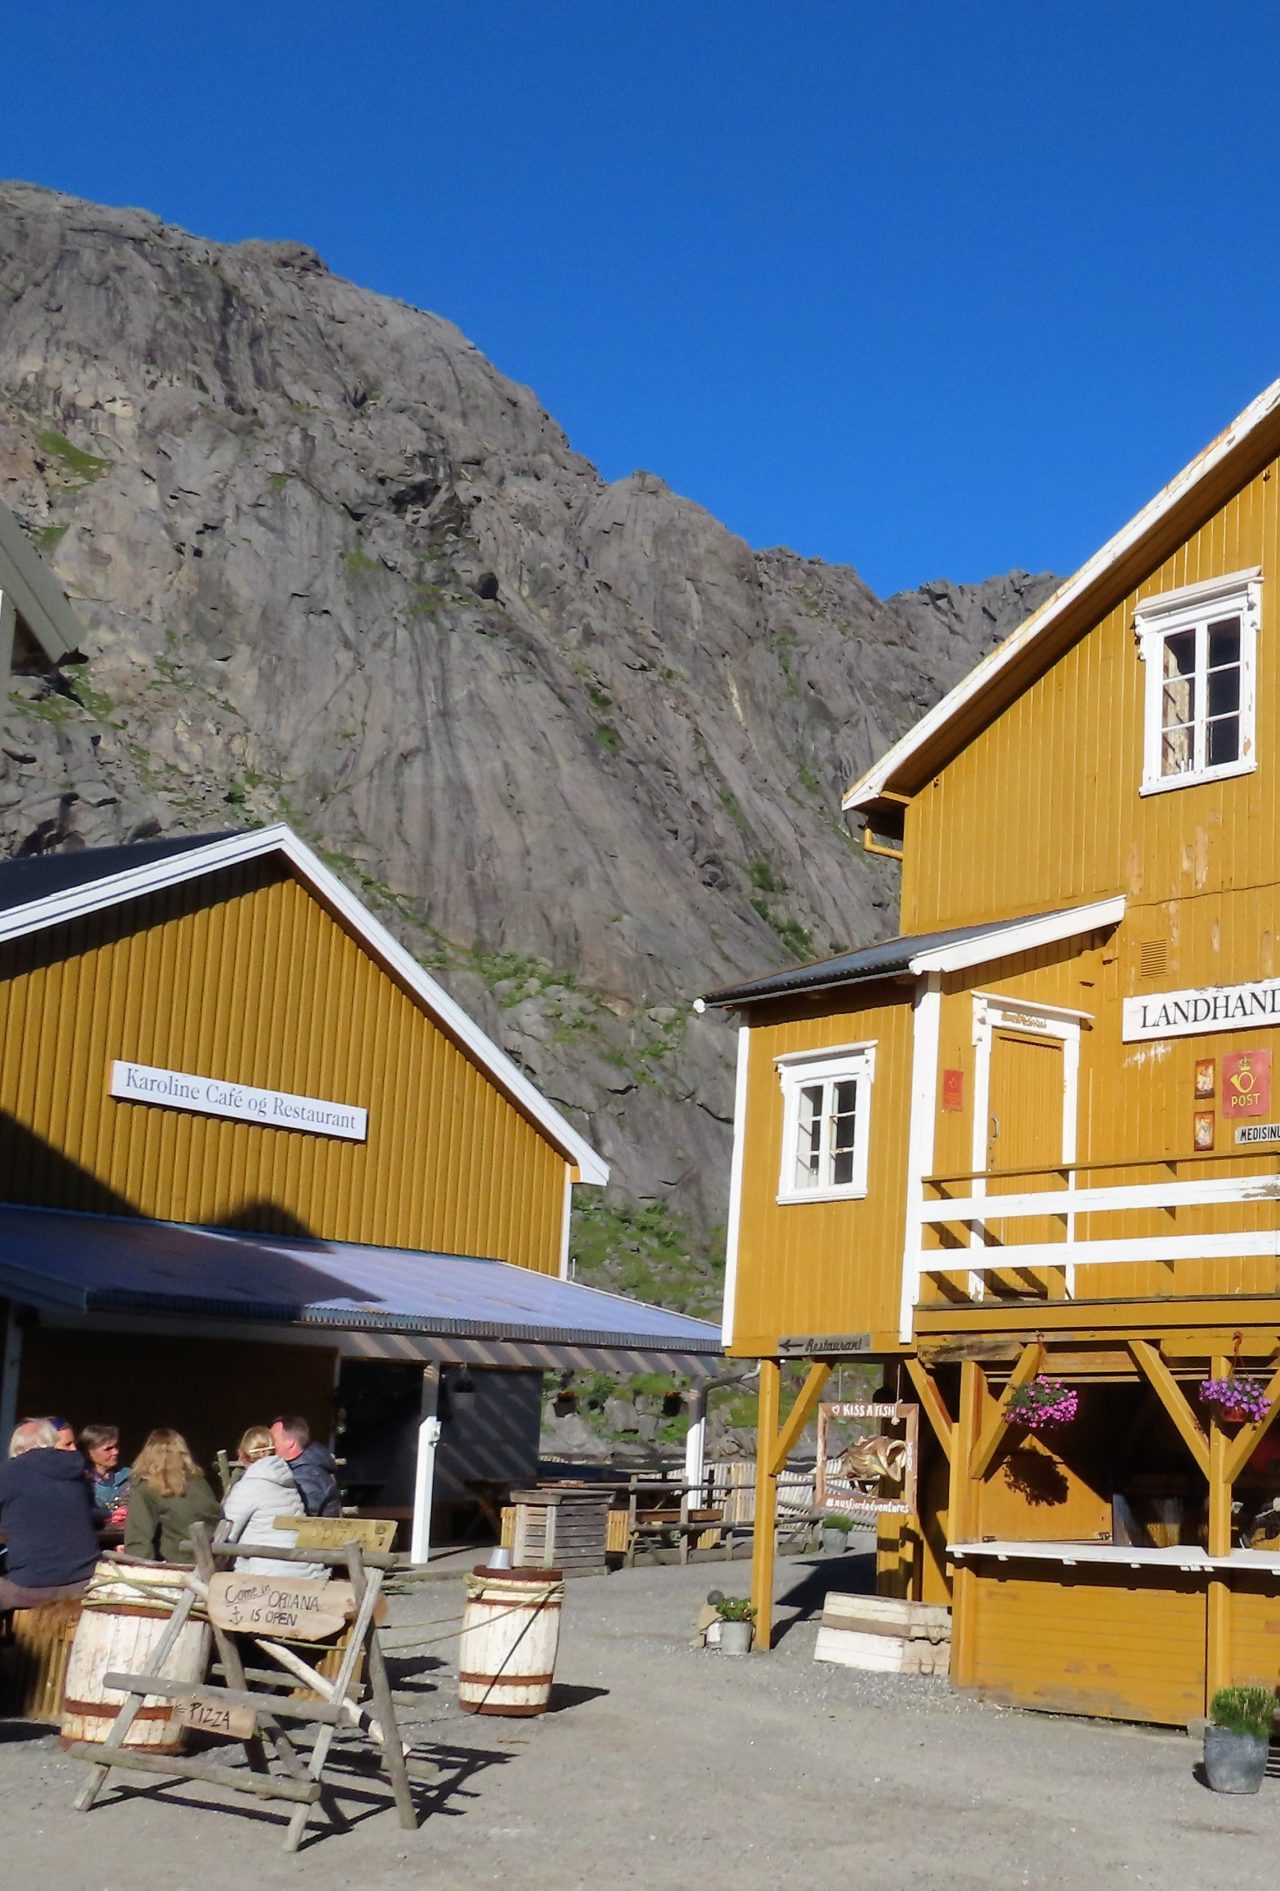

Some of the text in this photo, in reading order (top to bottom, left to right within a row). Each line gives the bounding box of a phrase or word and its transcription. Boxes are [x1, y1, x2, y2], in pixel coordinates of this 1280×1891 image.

[125, 1067, 356, 1130] Karoline Café og Restaurant
[1231, 1092, 1262, 1108] POST
[805, 1338, 863, 1353] Restaurant
[842, 1404, 895, 1417] KISS A FISH
[225, 1584, 257, 1604] Come
[268, 1590, 320, 1612] ORIANA
[250, 1609, 298, 1627] IS OPEN
[188, 1701, 231, 1730] PIZZA
